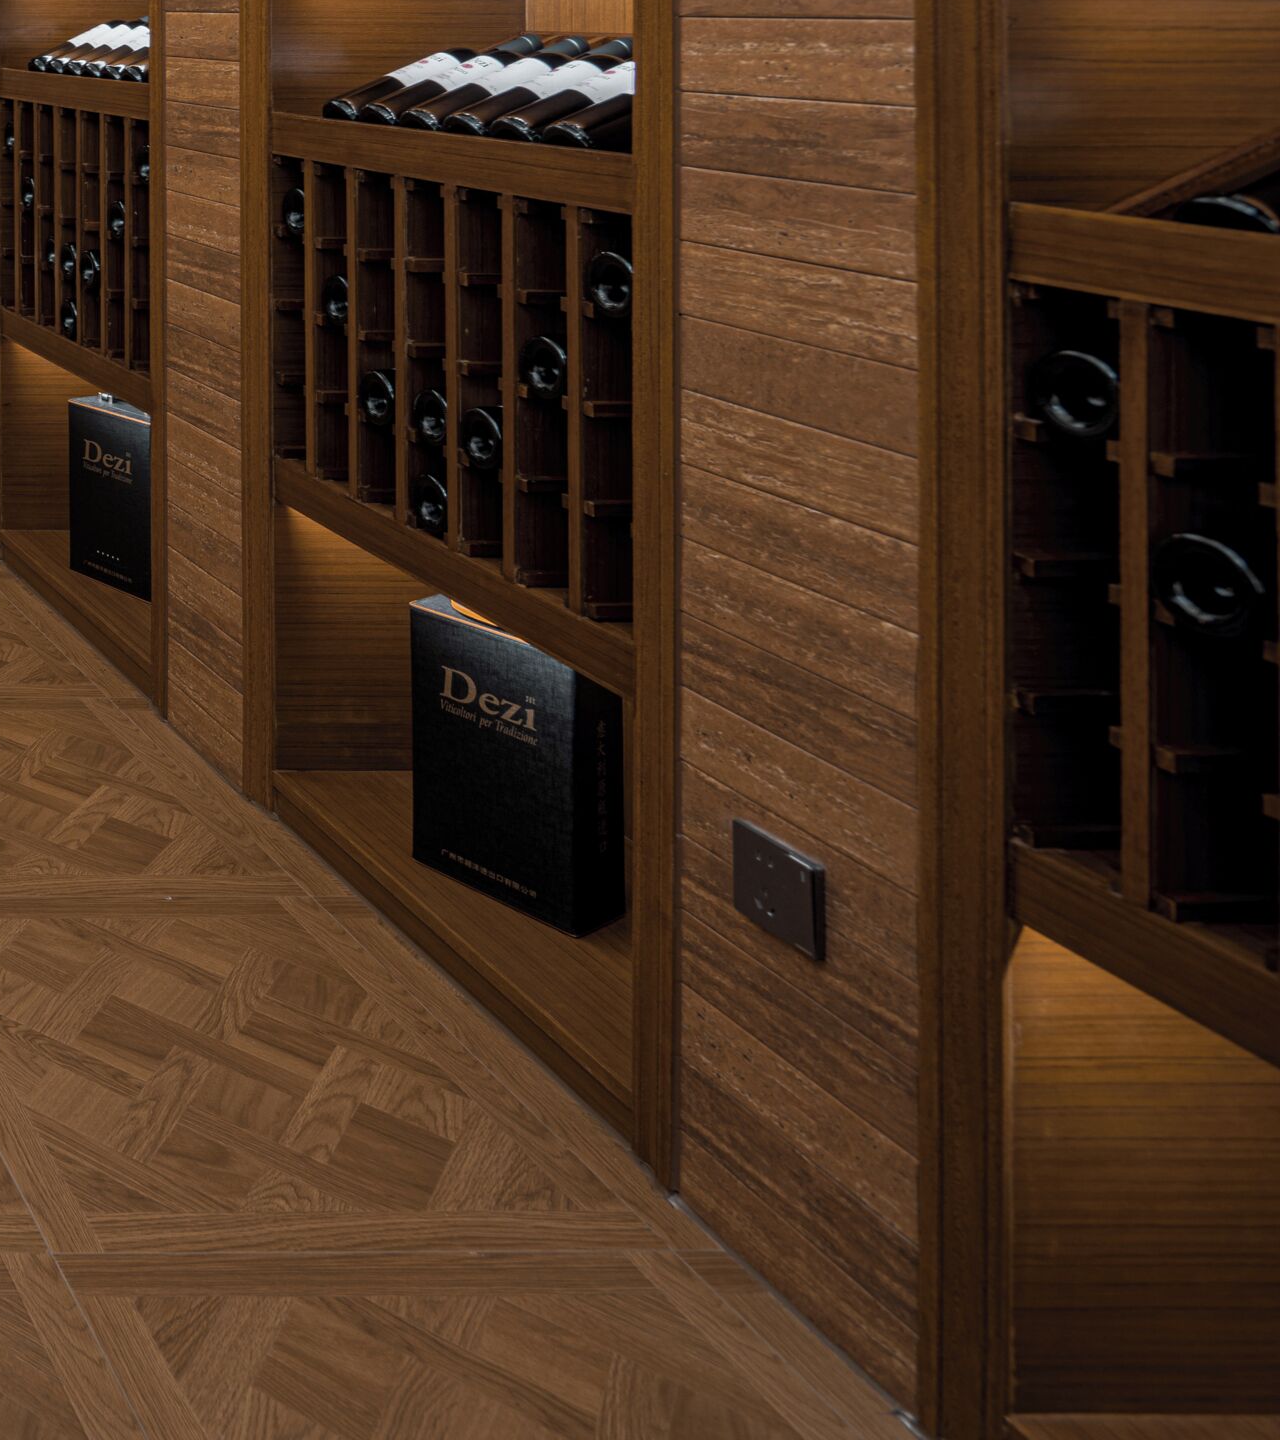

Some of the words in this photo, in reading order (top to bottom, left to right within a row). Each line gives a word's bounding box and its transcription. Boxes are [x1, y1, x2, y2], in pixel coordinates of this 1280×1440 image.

[82, 438, 132, 475] Dezi
[440, 665, 537, 731] Dezi
[440, 698, 477, 722] Viticoltori
[479, 716, 493, 728] per
[495, 718, 539, 746] Tradizione
